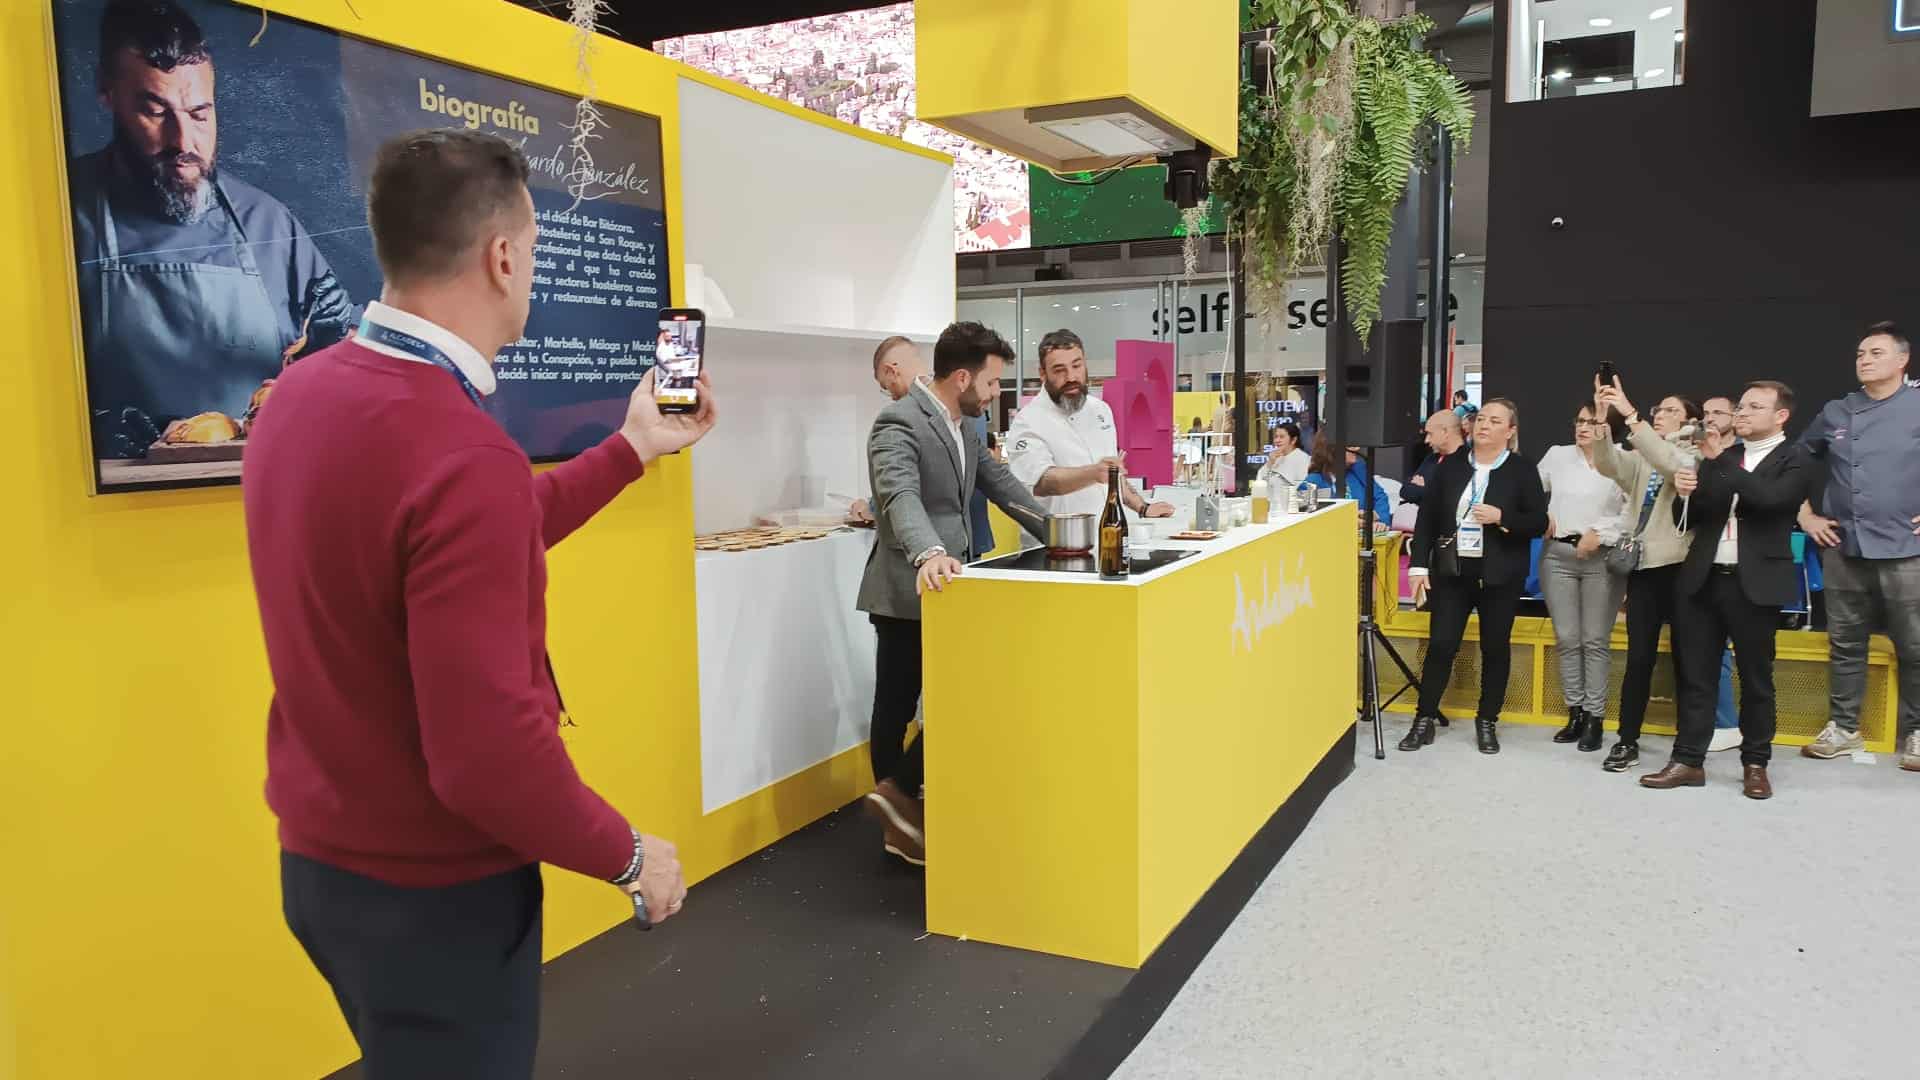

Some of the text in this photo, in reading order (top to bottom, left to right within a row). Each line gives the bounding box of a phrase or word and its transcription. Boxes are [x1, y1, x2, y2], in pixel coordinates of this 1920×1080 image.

[419, 78, 540, 135] biografía
[542, 209, 551, 221] el
[571, 213, 582, 226] de
[582, 216, 598, 228] Bar
[584, 231, 595, 243] de
[598, 233, 615, 246] San
[648, 243, 655, 254] y
[583, 249, 600, 261] que
[601, 249, 621, 262] data
[623, 251, 646, 264] desde
[647, 254, 656, 266] el
[566, 259, 576, 272] el
[583, 265, 600, 277] que
[608, 264, 620, 276] ha
[628, 268, 657, 280] crecido
[554, 277, 591, 289] sectores
[592, 277, 634, 292] hosteleros
[636, 285, 657, 295] como
[541, 292, 549, 304] y
[552, 292, 607, 305] restaurantes
[610, 295, 622, 306] de
[1152, 291, 1230, 336] self
[544, 335, 586, 352] Marbella,
[588, 338, 620, 353] Málaga
[623, 343, 630, 354] y
[631, 339, 657, 352] Madri
[513, 350, 526, 363] de
[528, 351, 539, 363] la
[597, 356, 607, 365] su
[609, 354, 637, 368] pueblo
[497, 366, 529, 379] decide
[530, 367, 559, 379] iniciar
[561, 371, 572, 380] su
[574, 368, 603, 383] propio
[1255, 400, 1305, 413] TOTEM
